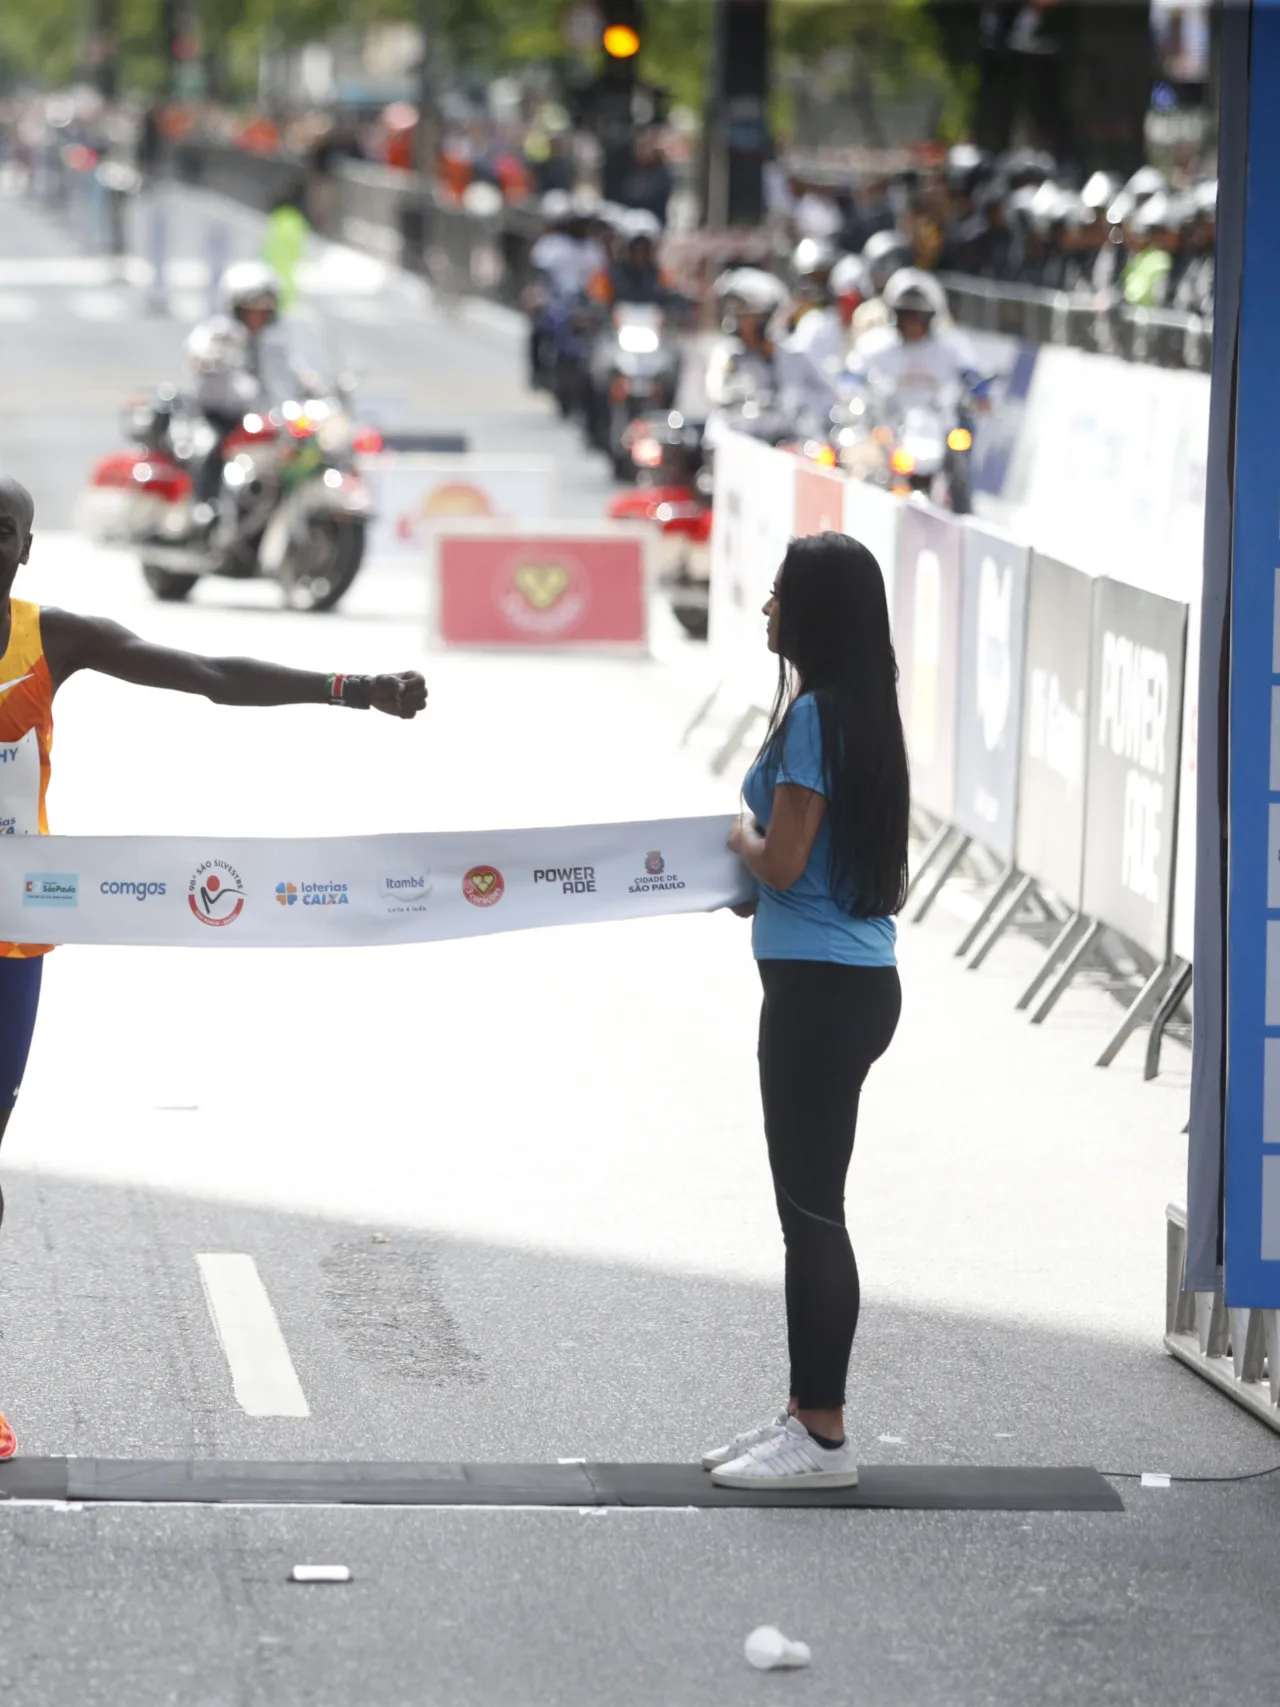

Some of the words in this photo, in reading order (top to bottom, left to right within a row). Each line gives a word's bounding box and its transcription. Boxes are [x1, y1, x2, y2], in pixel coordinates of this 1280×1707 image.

[214, 859, 244, 890] SILVESTRE
[533, 866, 595, 883] POWER
[634, 875, 665, 885] CIDADE
[666, 874, 678, 882] DE
[301, 880, 348, 893] loterias
[386, 876, 425, 889] Itambé
[563, 880, 596, 894] ADE
[628, 882, 650, 893] SÃO
[651, 881, 686, 891] PAULO
[302, 893, 349, 906] CAIXA
